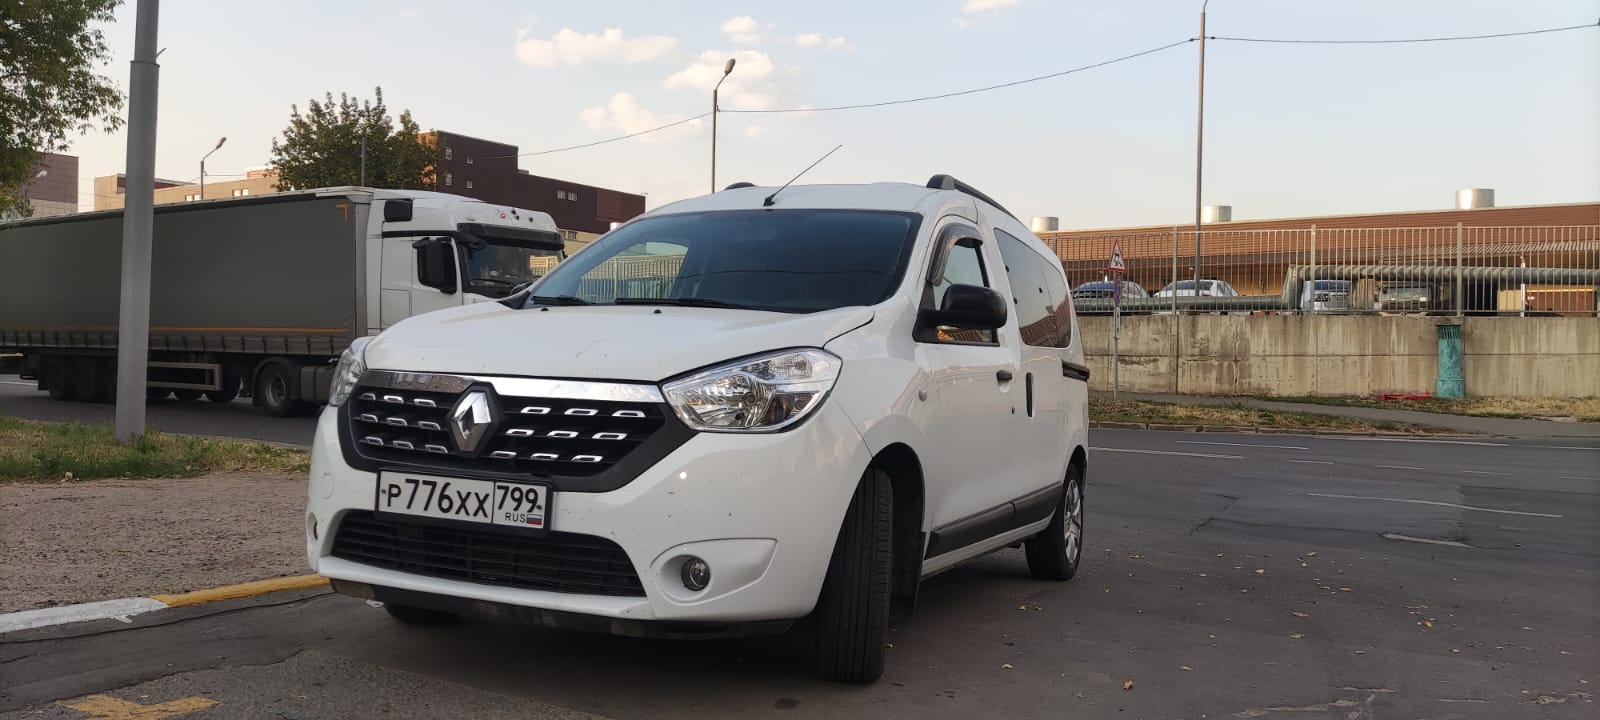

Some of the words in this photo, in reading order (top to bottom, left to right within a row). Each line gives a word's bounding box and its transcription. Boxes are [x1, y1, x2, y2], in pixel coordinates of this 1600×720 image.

[387, 478, 490, 518] P776XX
[496, 485, 538, 513] 799
[504, 512, 526, 523] RUS
